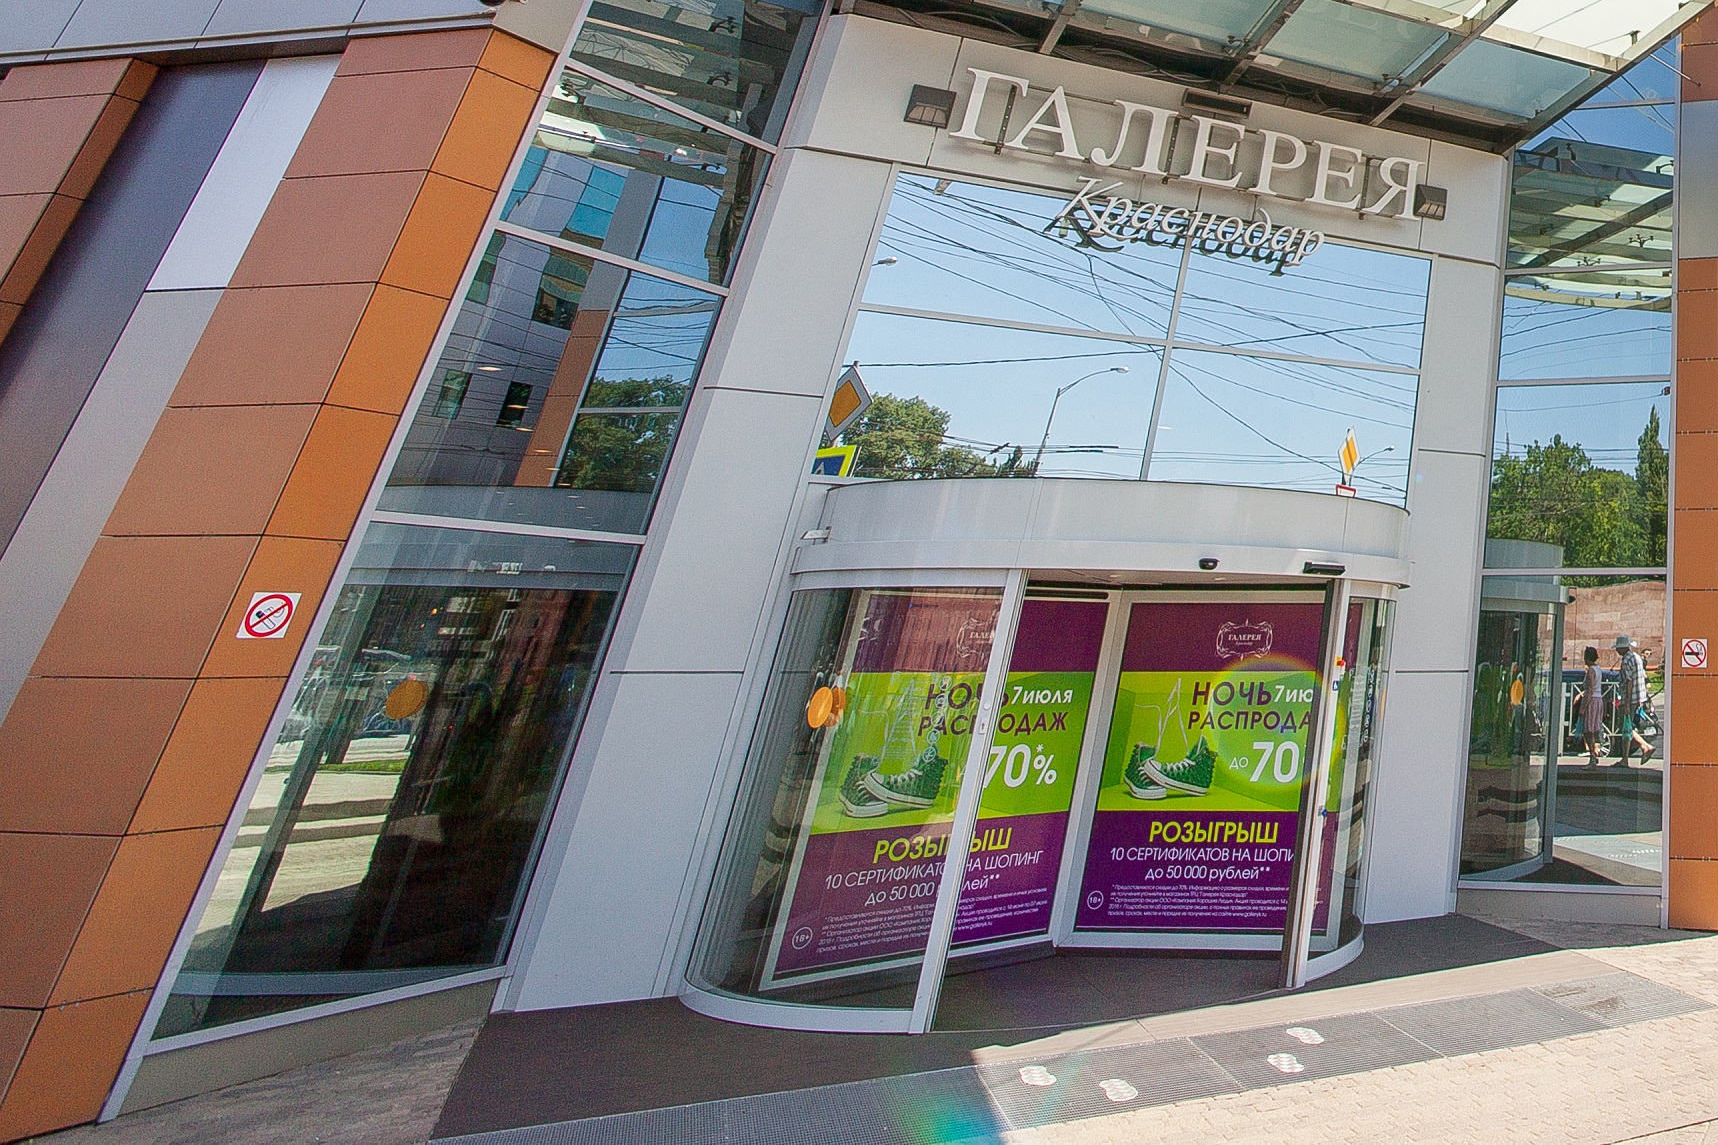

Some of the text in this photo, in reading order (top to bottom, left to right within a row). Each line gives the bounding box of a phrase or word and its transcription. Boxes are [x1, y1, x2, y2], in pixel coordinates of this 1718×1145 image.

[949, 67, 1428, 221] ГАЛЕРЕЯ
[1056, 175, 1325, 267] Краснодар
[1228, 633, 1261, 642] ГАЛЕРЕЯ
[1191, 681, 1272, 706] НОЧЬ
[1229, 757, 1249, 770] до
[1149, 821, 1279, 843] РОЗЫГРЫШ
[1110, 847, 1124, 861] 10
[1126, 847, 1230, 861] СЕРТИФИКАТОВ
[1232, 848, 1251, 861] НА
[825, 874, 842, 890] 10
[984, 850, 1044, 870] ШОПИНГ
[1145, 868, 1163, 880] до
[1166, 866, 1182, 879] 50
[1183, 865, 1207, 879] 000
[865, 887, 886, 907] до
[889, 883, 908, 901] 50
[909, 881, 935, 899] 000
